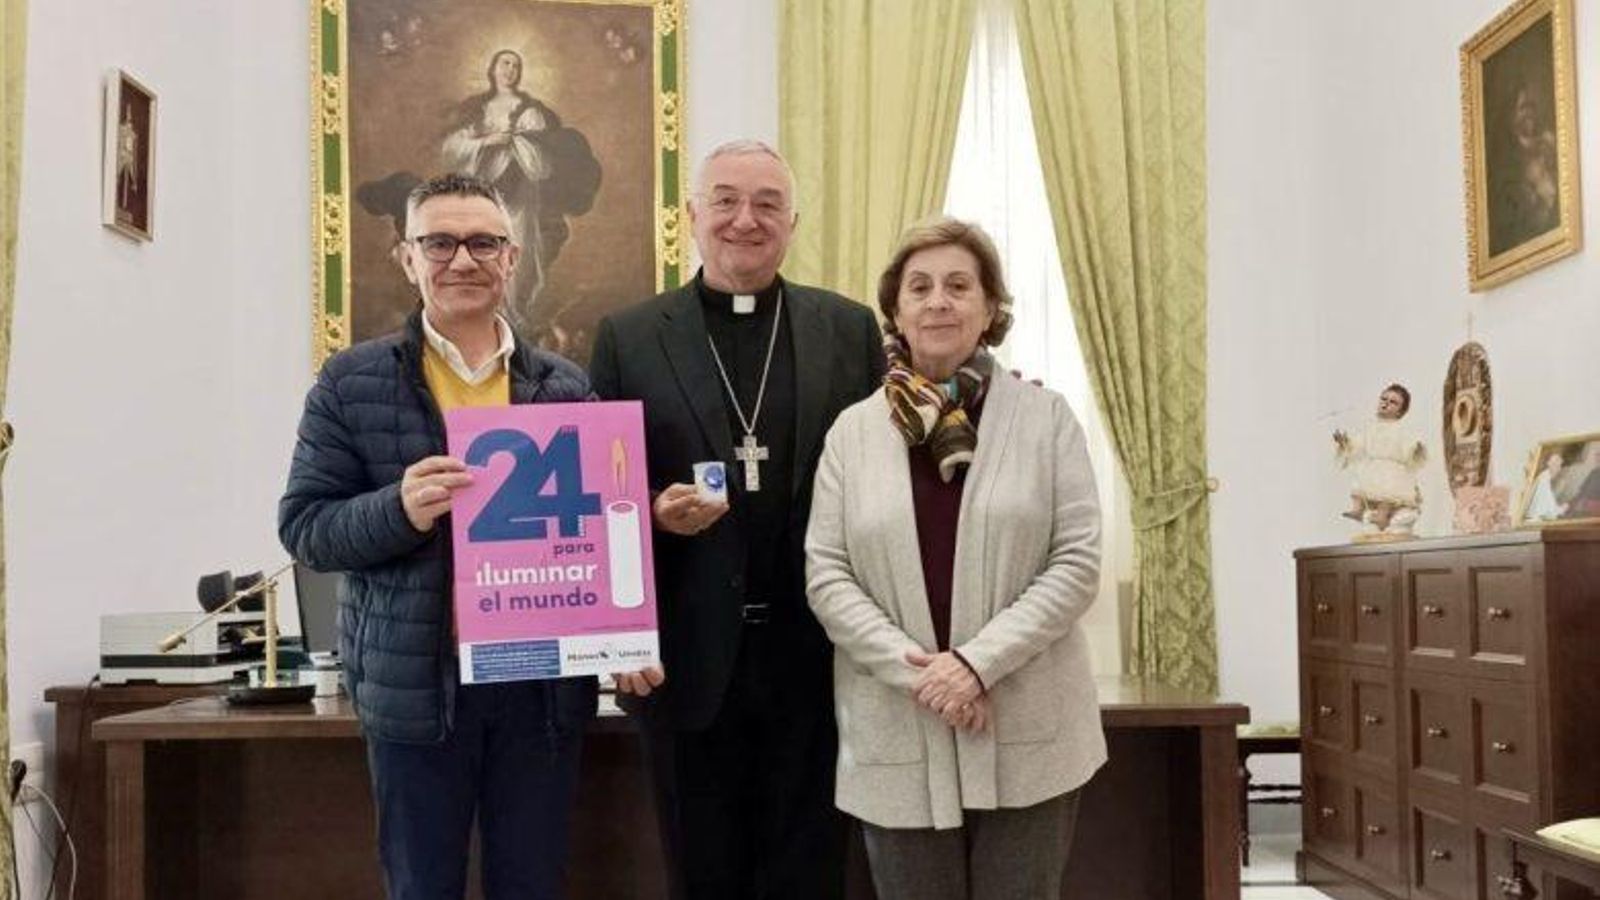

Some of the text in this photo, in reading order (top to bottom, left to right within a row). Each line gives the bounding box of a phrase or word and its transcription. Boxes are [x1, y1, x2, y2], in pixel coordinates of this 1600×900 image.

[464, 425, 602, 542] 24
[553, 542, 595, 558] para
[476, 561, 598, 586] iluminar
[479, 586, 598, 612] el mundo
